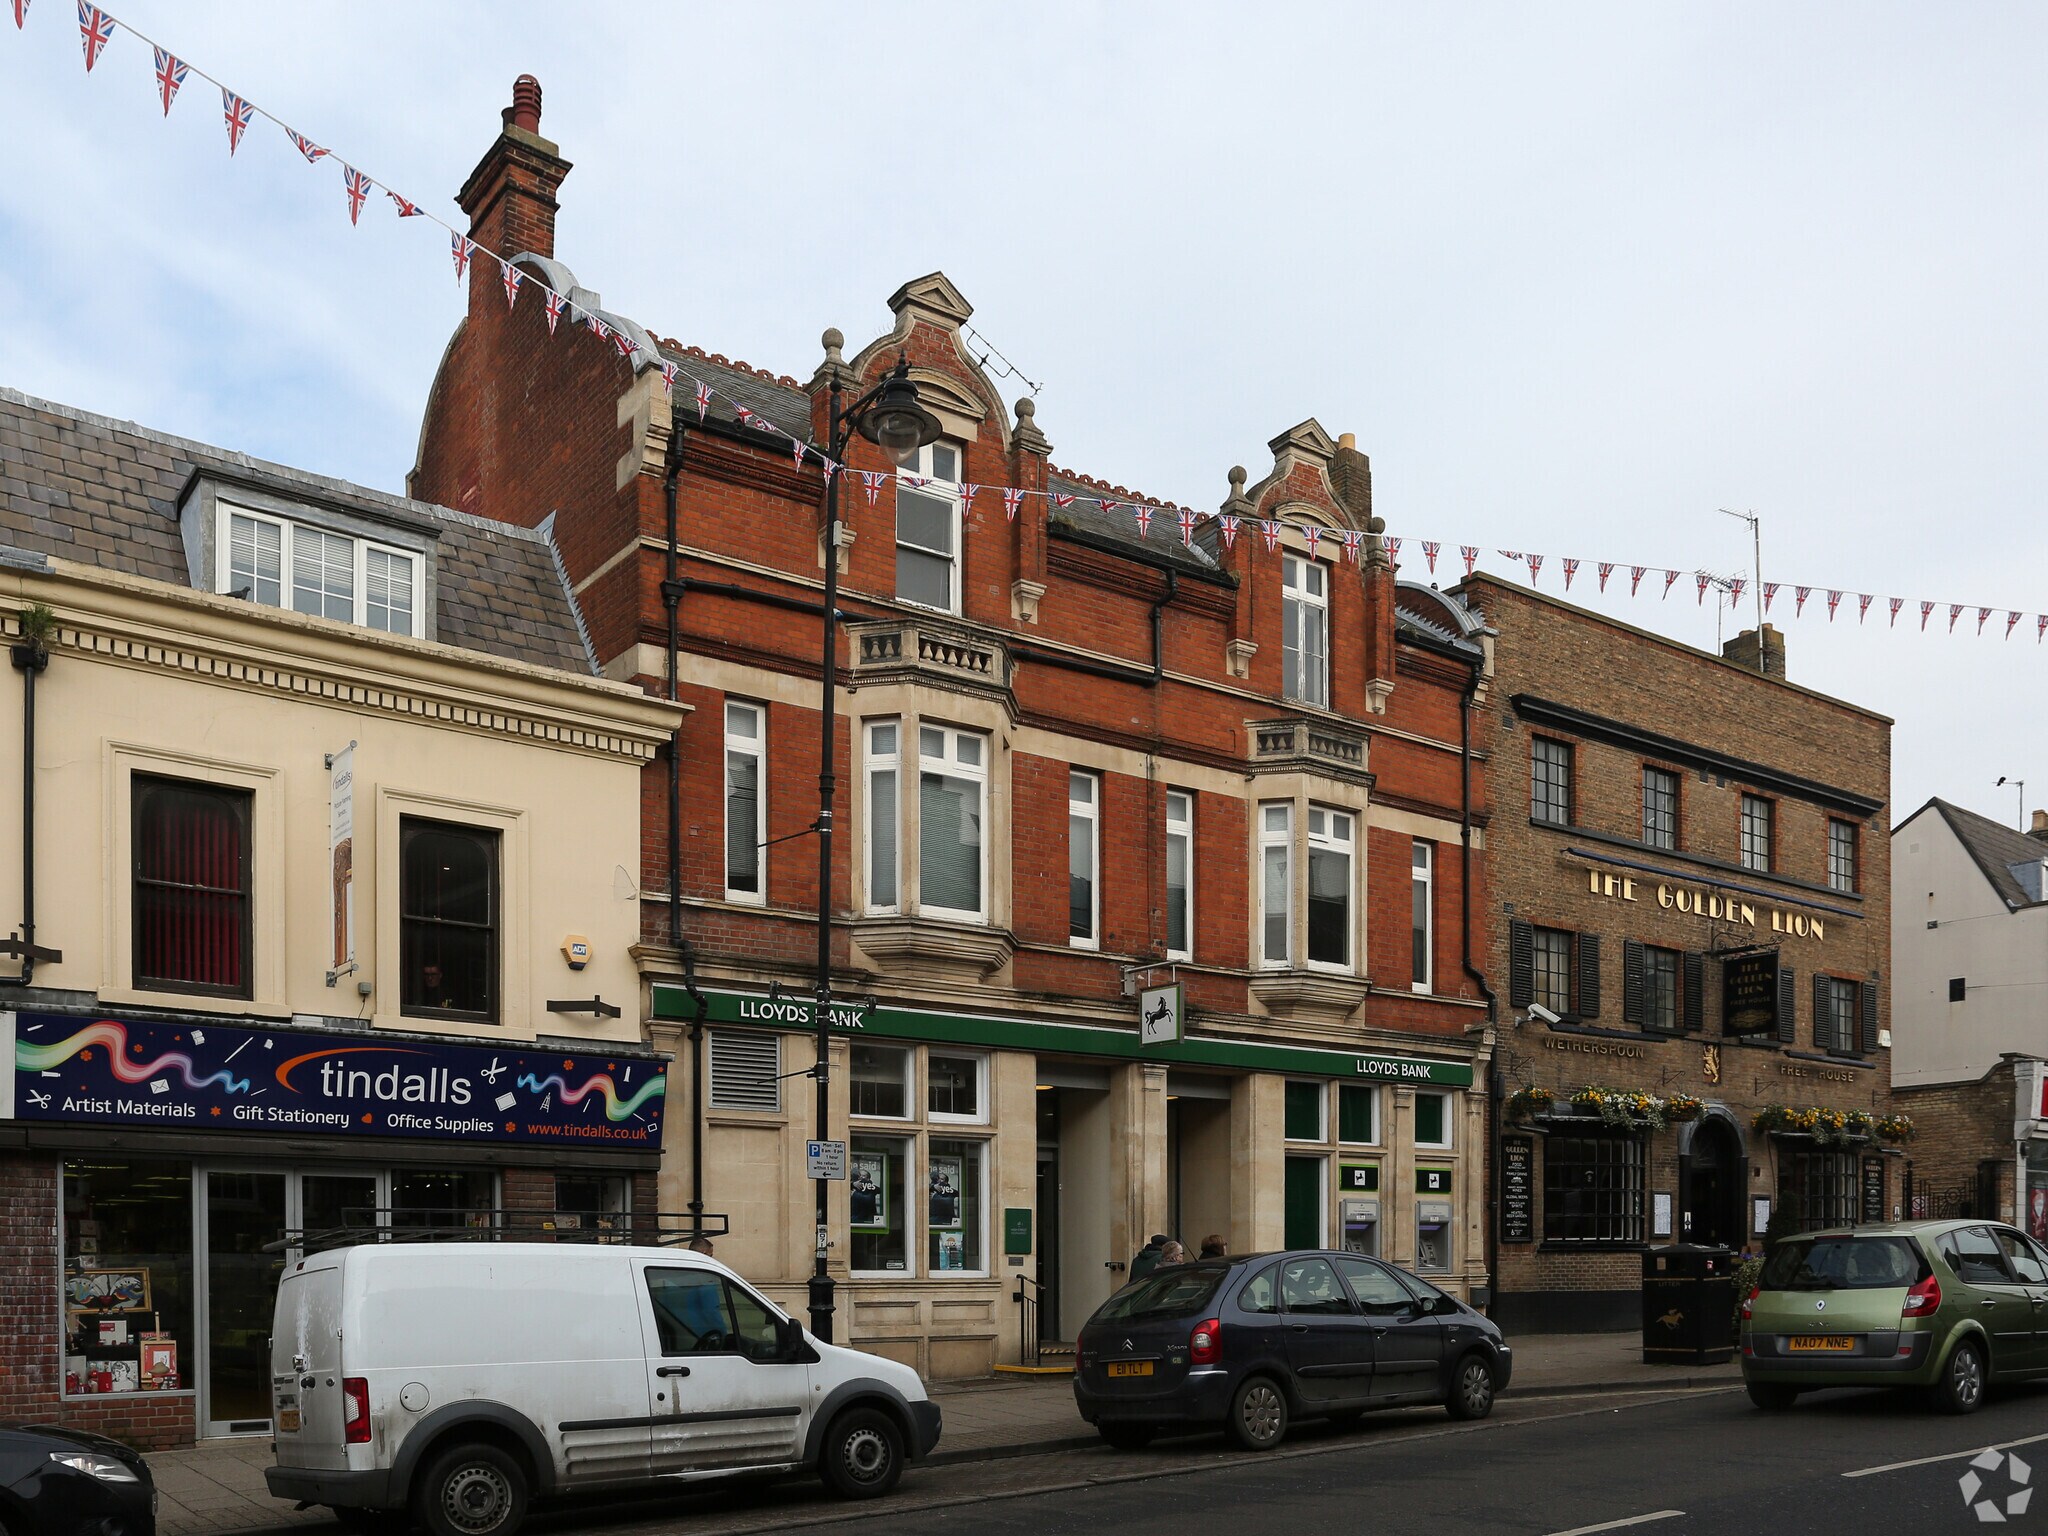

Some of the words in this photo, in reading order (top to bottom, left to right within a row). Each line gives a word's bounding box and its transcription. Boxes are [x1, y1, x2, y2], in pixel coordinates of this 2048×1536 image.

[1587, 868, 1638, 902] THE
[1657, 883, 1755, 928] GOLDEN
[1771, 909, 1824, 940] LION
[573, 945, 586, 953] ADT
[740, 1001, 810, 1023] LLOYDS
[815, 1008, 864, 1028] ANK
[1544, 1036, 1644, 1058] WETHERSPOON
[1357, 1060, 1398, 1075] LLOYDS
[1401, 1064, 1431, 1078] BANK
[1780, 1065, 1808, 1077] FREE
[1818, 1069, 1854, 1082] HOUSE
[320, 1060, 472, 1105] tindalls
[62, 1096, 112, 1114] Artist
[116, 1099, 196, 1118] Materials
[233, 1105, 263, 1121] Gift
[267, 1107, 350, 1129] Stationery
[387, 1114, 431, 1131] Office
[435, 1115, 494, 1134] Supplies
[527, 1122, 647, 1140] www.tindalls.co.uk
[811, 1145, 819, 1156] P
[859, 1161, 877, 1170] said
[938, 1165, 955, 1174] said
[861, 1182, 876, 1192] yes
[941, 1186, 954, 1195] yes
[1794, 1337, 1825, 1348] NA07
[1826, 1337, 1849, 1348] NNE
[1127, 1362, 1144, 1375] TLT
